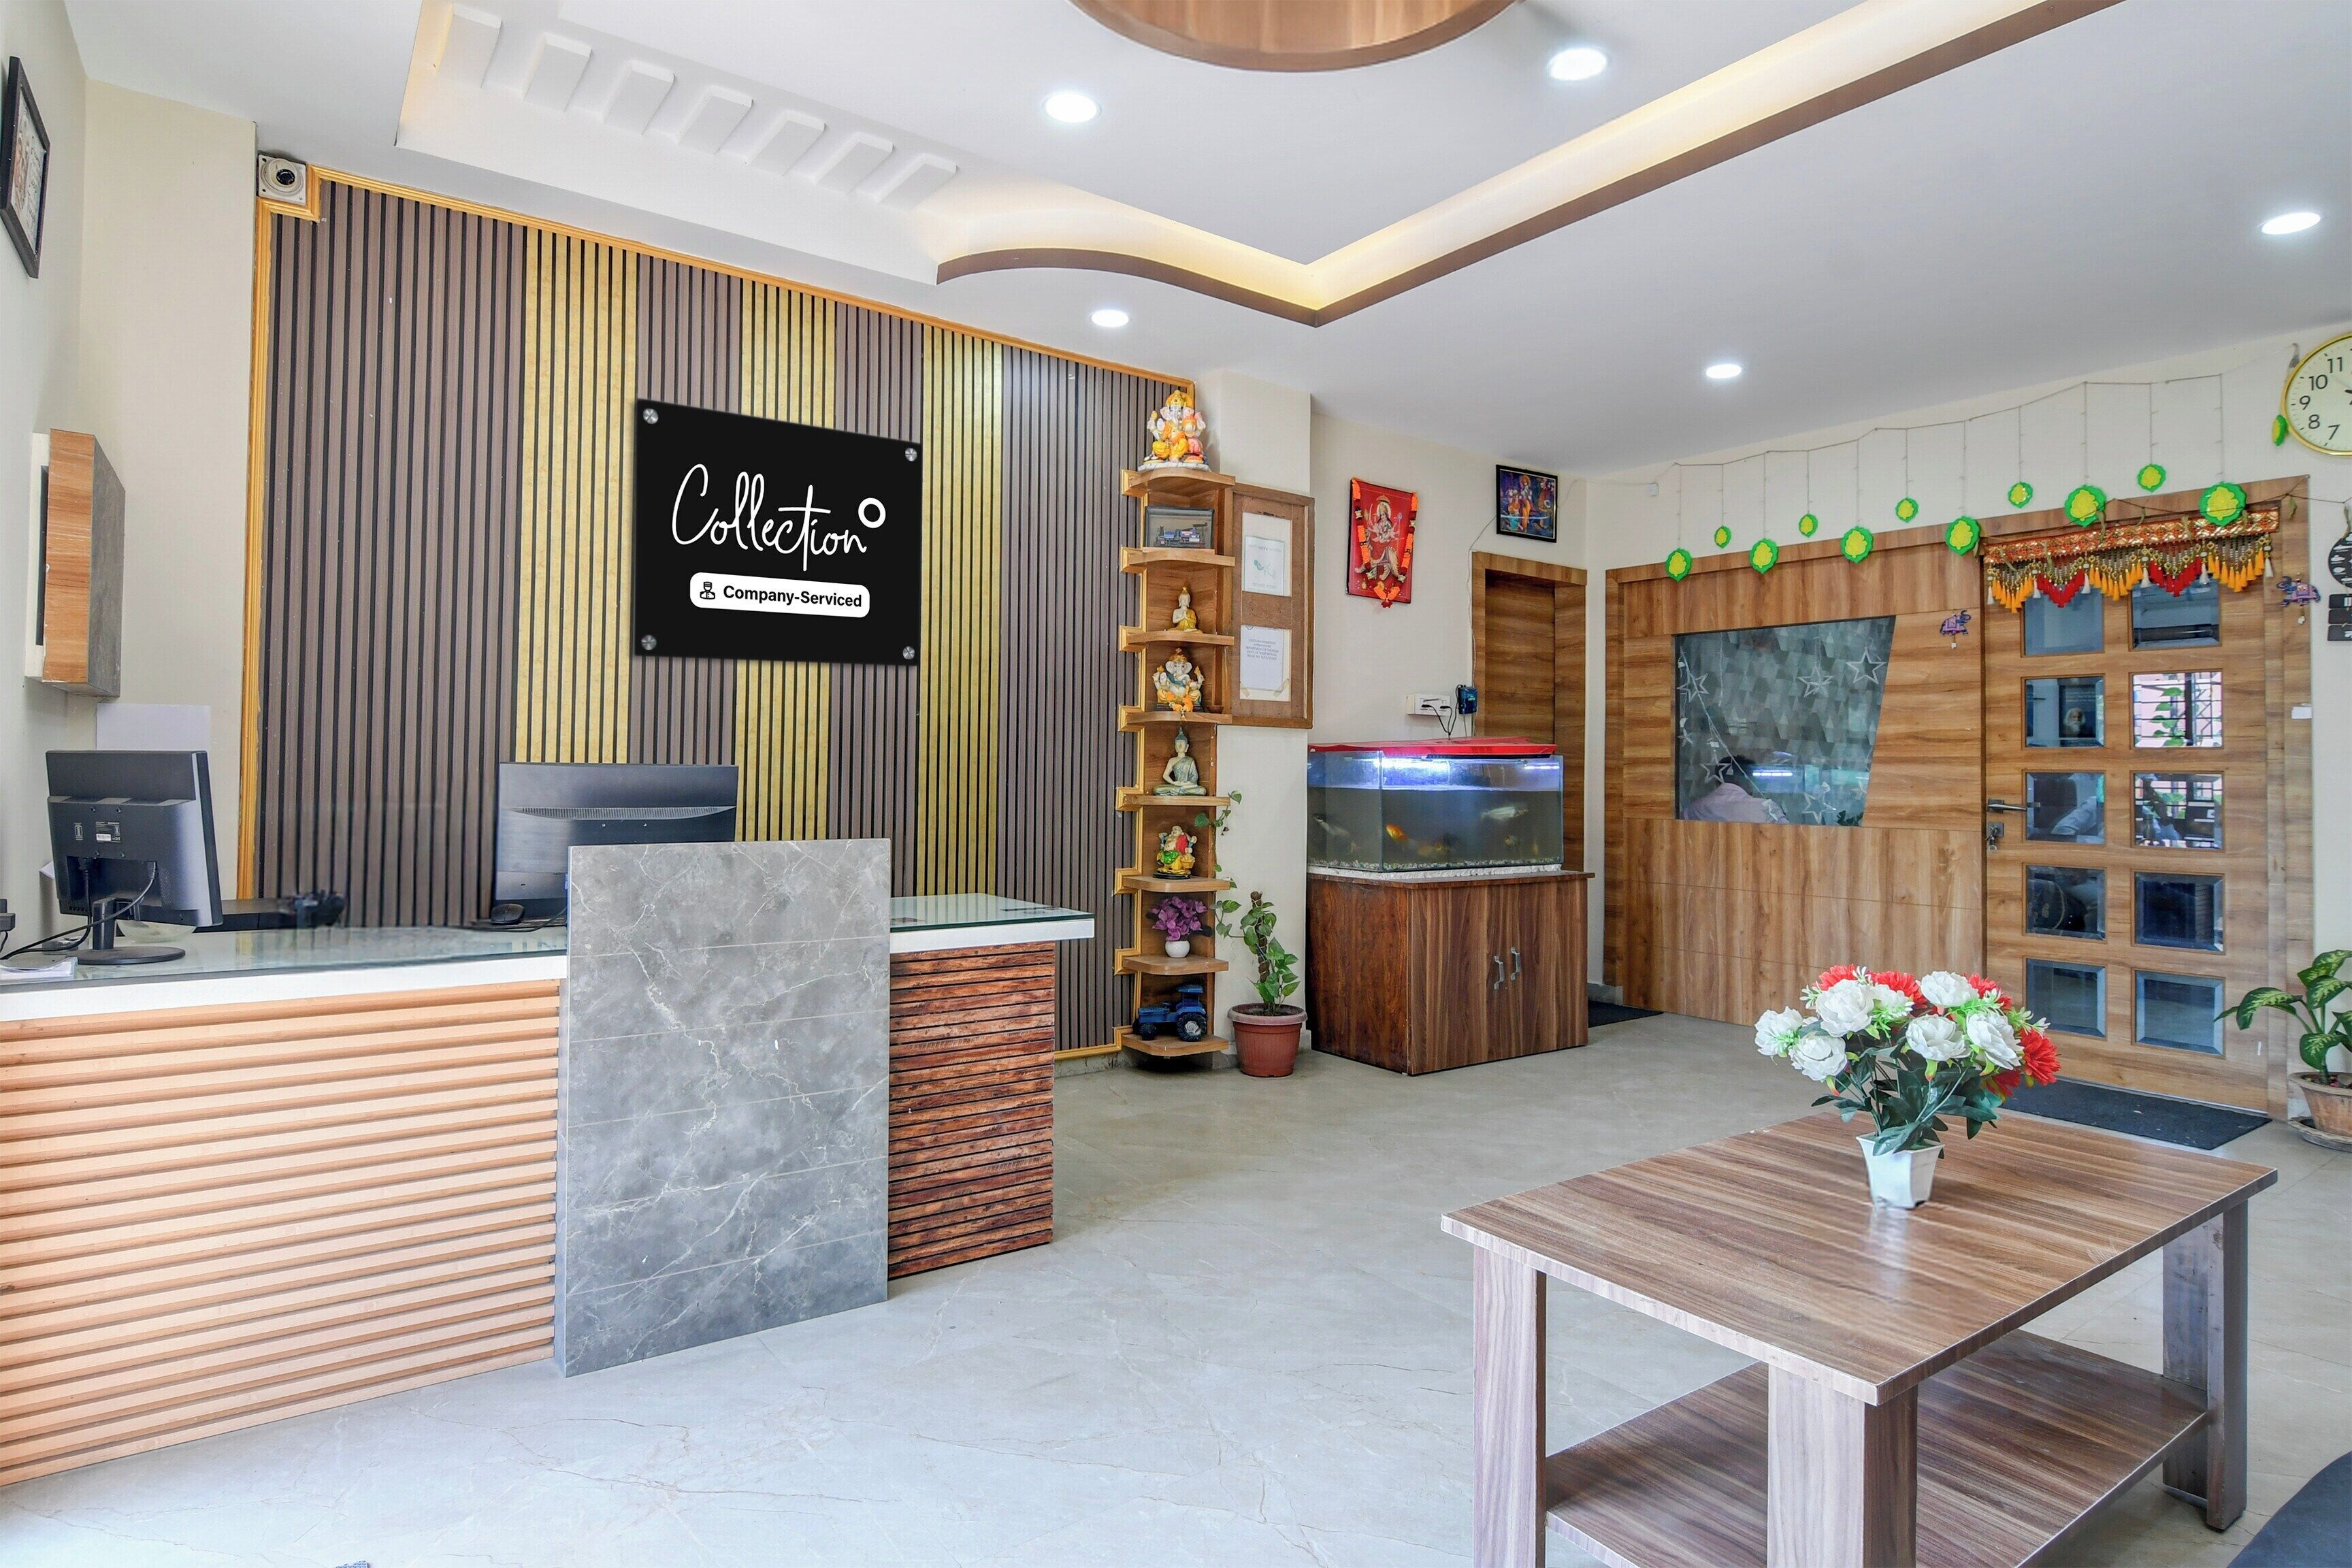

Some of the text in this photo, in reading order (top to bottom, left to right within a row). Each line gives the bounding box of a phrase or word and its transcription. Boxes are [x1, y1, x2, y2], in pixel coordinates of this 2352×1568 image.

[2328, 357, 2342, 373] 11
[2308, 374, 2328, 391] 10
[2299, 395, 2310, 410] 9
[2308, 414, 2320, 429] 8
[2328, 424, 2340, 440] 7
[672, 463, 867, 572] Collection
[723, 585, 862, 608] Company-Serviced
